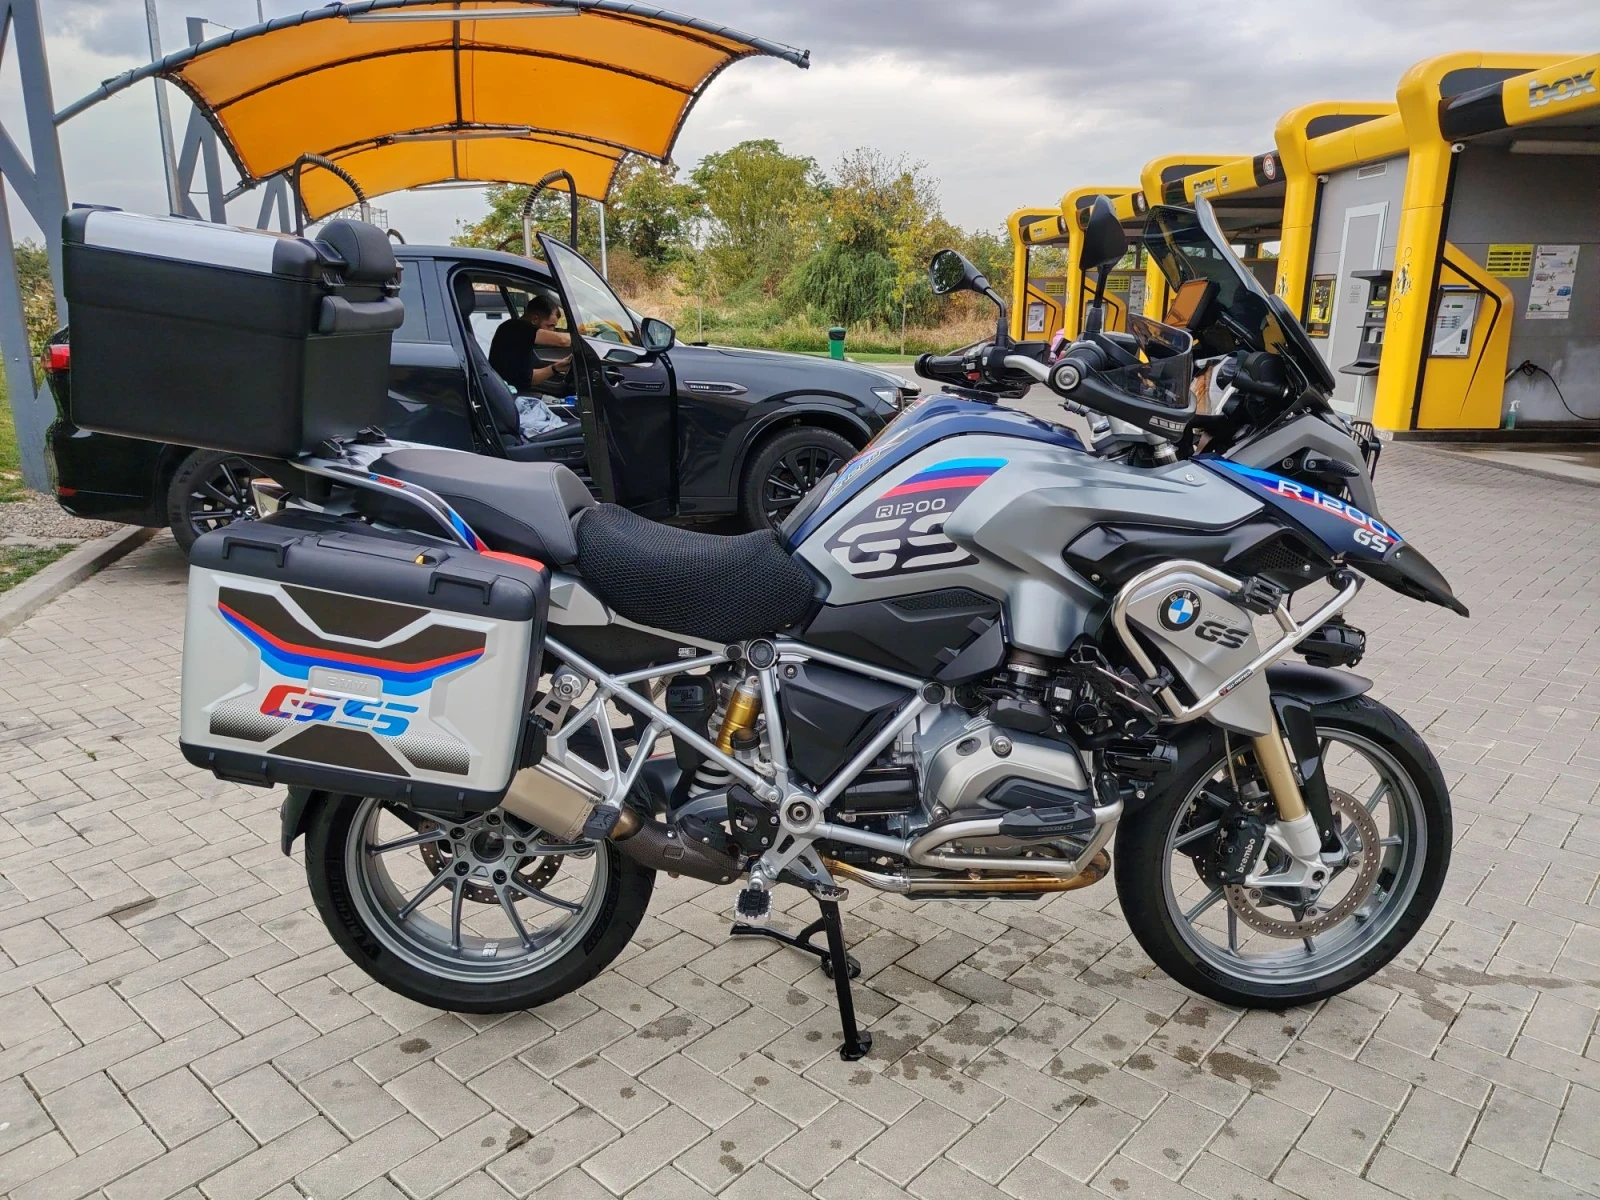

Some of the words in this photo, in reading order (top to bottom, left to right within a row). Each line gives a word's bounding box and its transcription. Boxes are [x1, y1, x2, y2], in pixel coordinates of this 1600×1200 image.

[1529, 68, 1597, 108] box
[875, 498, 946, 519] R1200
[1278, 480, 1302, 498] R
[1313, 491, 1388, 538] 1200
[830, 511, 972, 575] GS
[1353, 527, 1389, 553] GS
[1169, 591, 1200, 608] BMW
[1195, 620, 1250, 649] GS
[327, 676, 368, 692] BMW
[260, 685, 419, 737] GS
[1235, 838, 1256, 873] brembo
